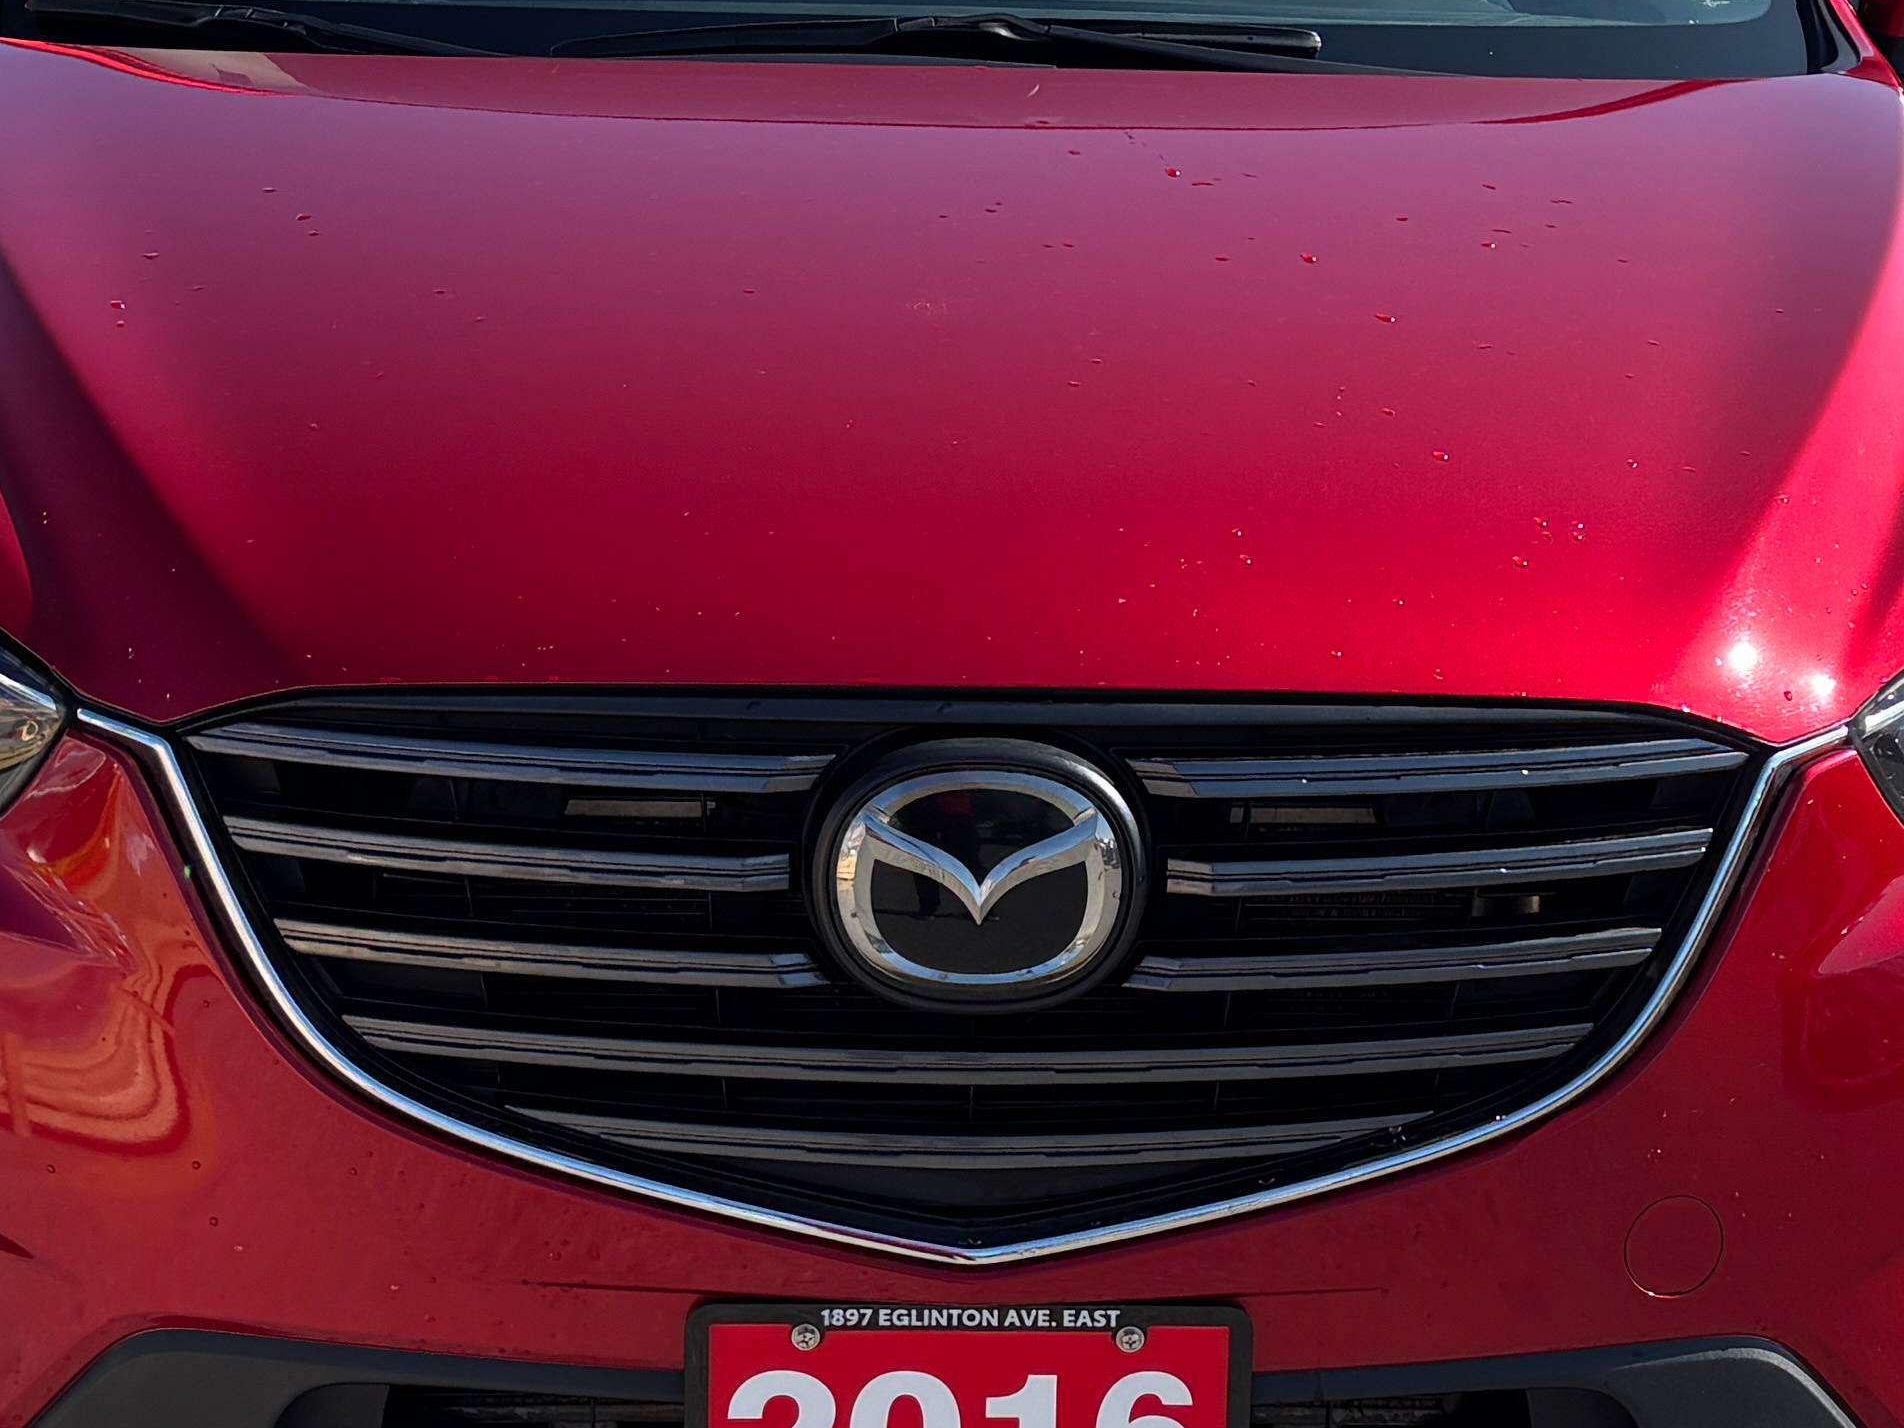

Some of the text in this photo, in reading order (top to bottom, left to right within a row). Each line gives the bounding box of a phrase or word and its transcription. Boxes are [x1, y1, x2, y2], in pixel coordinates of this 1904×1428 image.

[821, 1308, 1121, 1328] 1897 EGLINTON AVE. EAST
